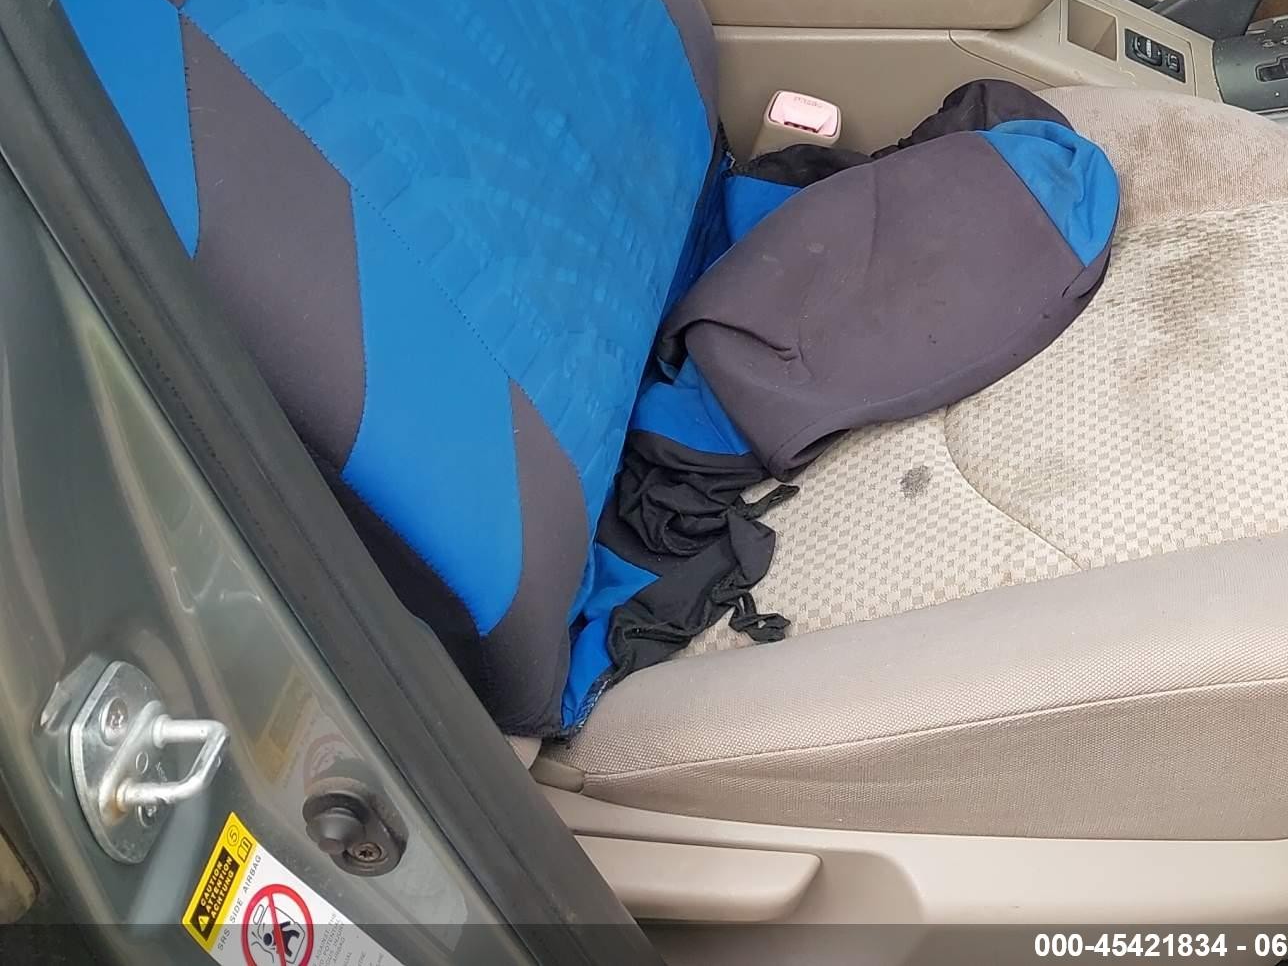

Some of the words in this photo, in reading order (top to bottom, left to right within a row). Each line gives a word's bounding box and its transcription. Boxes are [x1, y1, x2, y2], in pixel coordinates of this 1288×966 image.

[200, 860, 223, 907] CAUTION
[206, 856, 233, 913] ATTENTION
[210, 871, 234, 919] ACHTUNG
[217, 928, 231, 951] SRS
[229, 897, 244, 924] SIDE
[242, 854, 262, 894] AIRBAG
